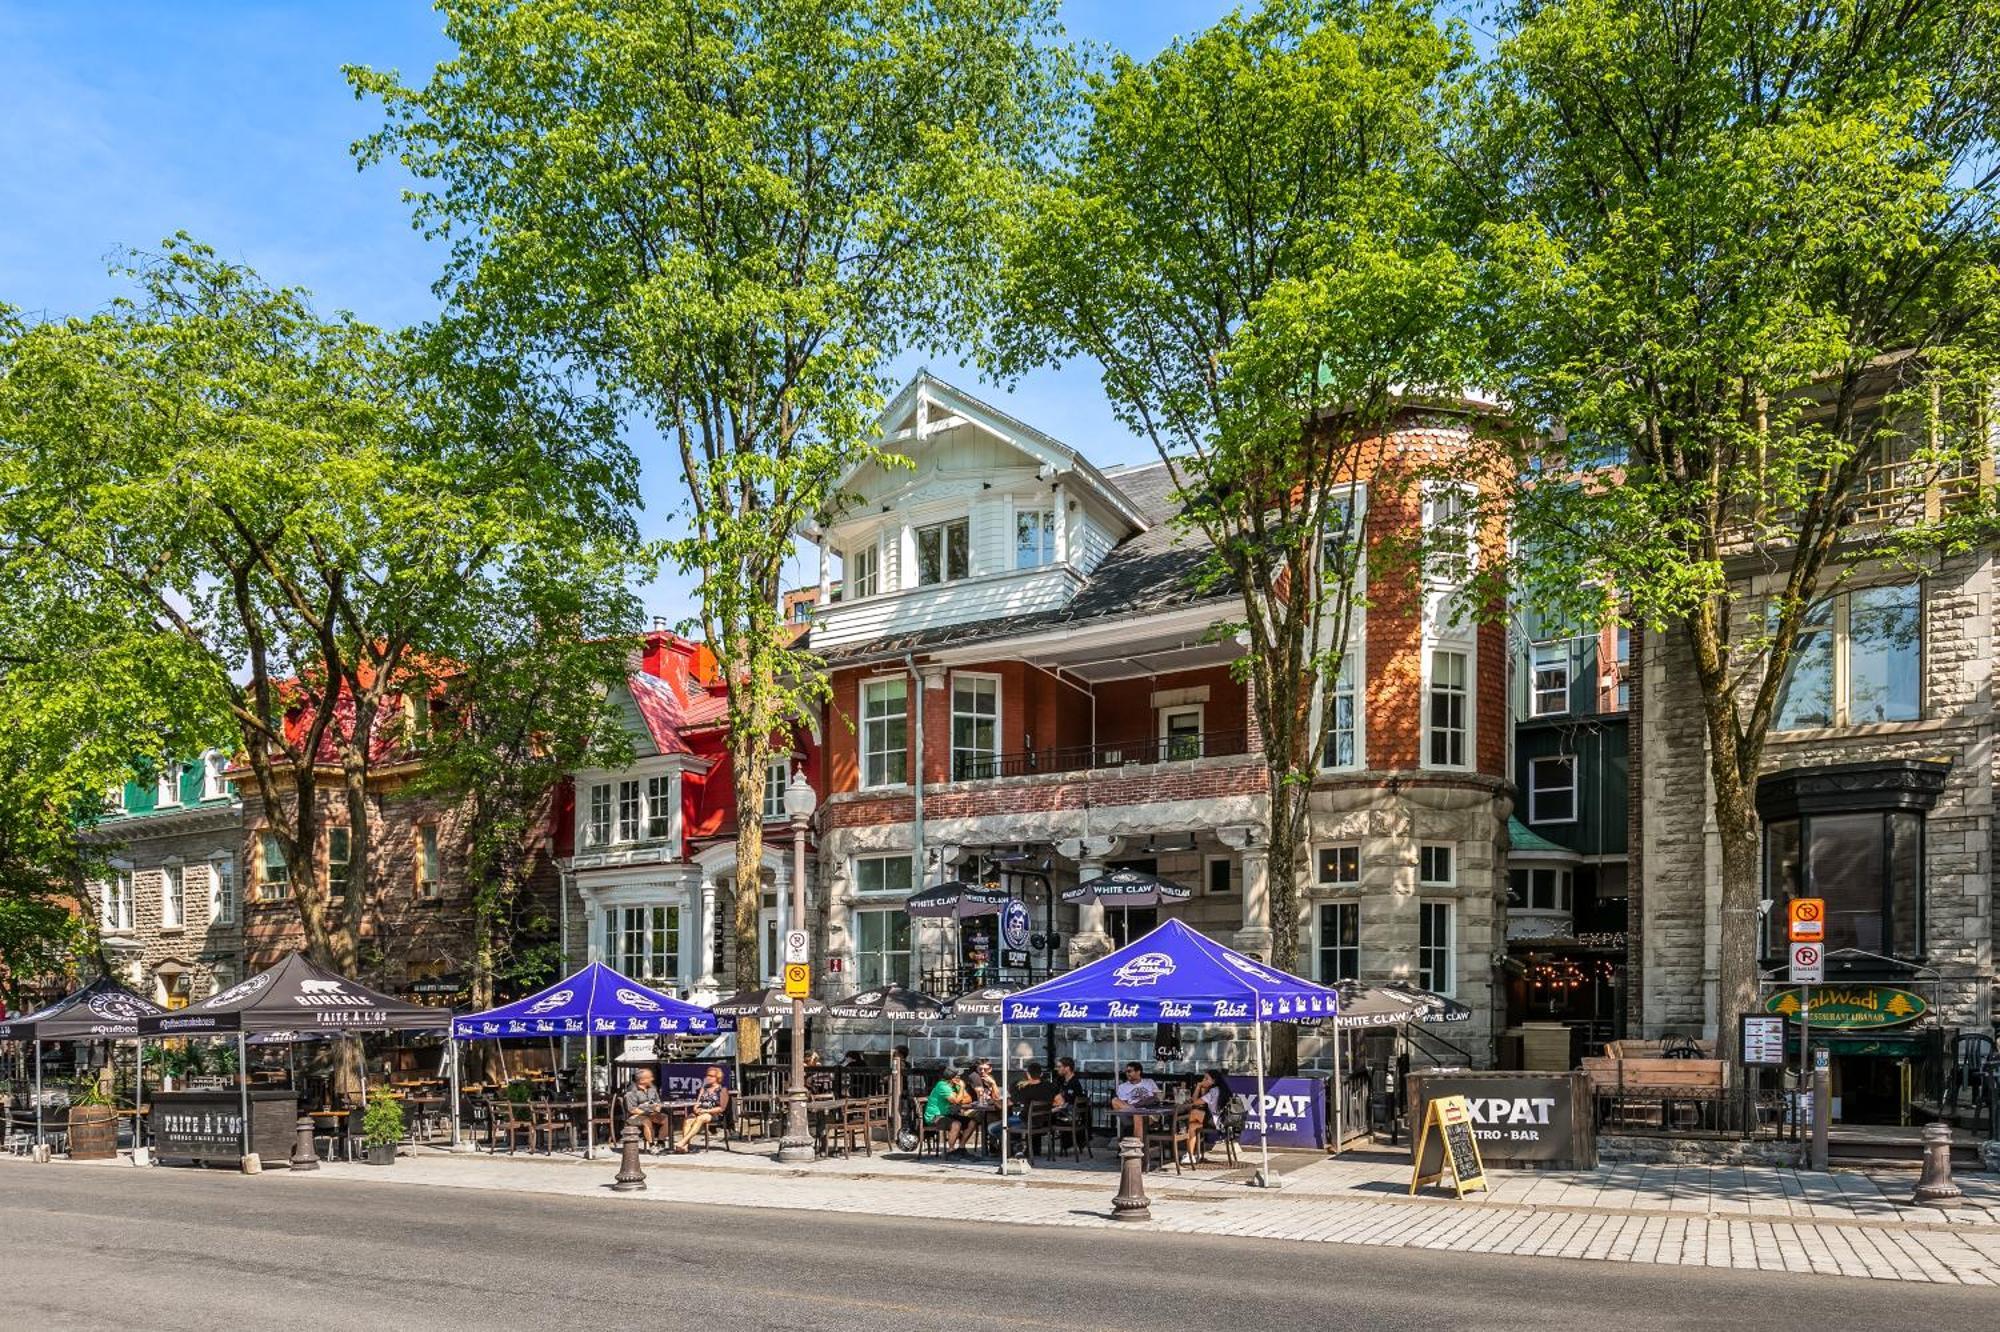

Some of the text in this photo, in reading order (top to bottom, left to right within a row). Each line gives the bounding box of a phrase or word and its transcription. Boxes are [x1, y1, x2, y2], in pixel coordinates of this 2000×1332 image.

[1093, 884, 1153, 894] WHITE CLAW
[937, 896, 958, 905] CLAW
[965, 895, 988, 903] WHITE
[1579, 932, 1628, 947] EXPA
[712, 1007, 737, 1015] WHITE
[803, 1006, 822, 1014] LAW
[831, 1007, 880, 1018] WHITE CLAW
[958, 1004, 991, 1013] WHITE
[1010, 1003, 1040, 1019] Pabst
[1058, 1002, 1089, 1018] Pabst
[1108, 1001, 1139, 1018] Pabst
[1159, 1000, 1192, 1017] Pabst
[1213, 1000, 1248, 1017] Pabst
[316, 1011, 348, 1022] FAITE
[364, 1011, 387, 1022] L'OS
[887, 1012, 915, 1020] WHITE
[1373, 1012, 1406, 1024] CLAW
[1446, 1012, 1470, 1021] CLAW
[1808, 1012, 1850, 1022] ESTAURANT
[483, 1022, 500, 1034] Pabst
[509, 1020, 527, 1032] Pabst
[536, 1020, 554, 1031] Pabst
[565, 1019, 583, 1031] Pabst
[595, 1018, 616, 1031] Pabst
[629, 1017, 648, 1030] Pabst
[660, 1017, 678, 1029] Pabst
[689, 1016, 707, 1029] Pabst
[1238, 1094, 1312, 1117] XPAT
[1464, 1098, 1555, 1124] XPAT
[164, 1115, 199, 1132] FAITE
[216, 1116, 242, 1134] L'OS
[1275, 1123, 1297, 1132] BAR
[1511, 1130, 1539, 1140] BAR
